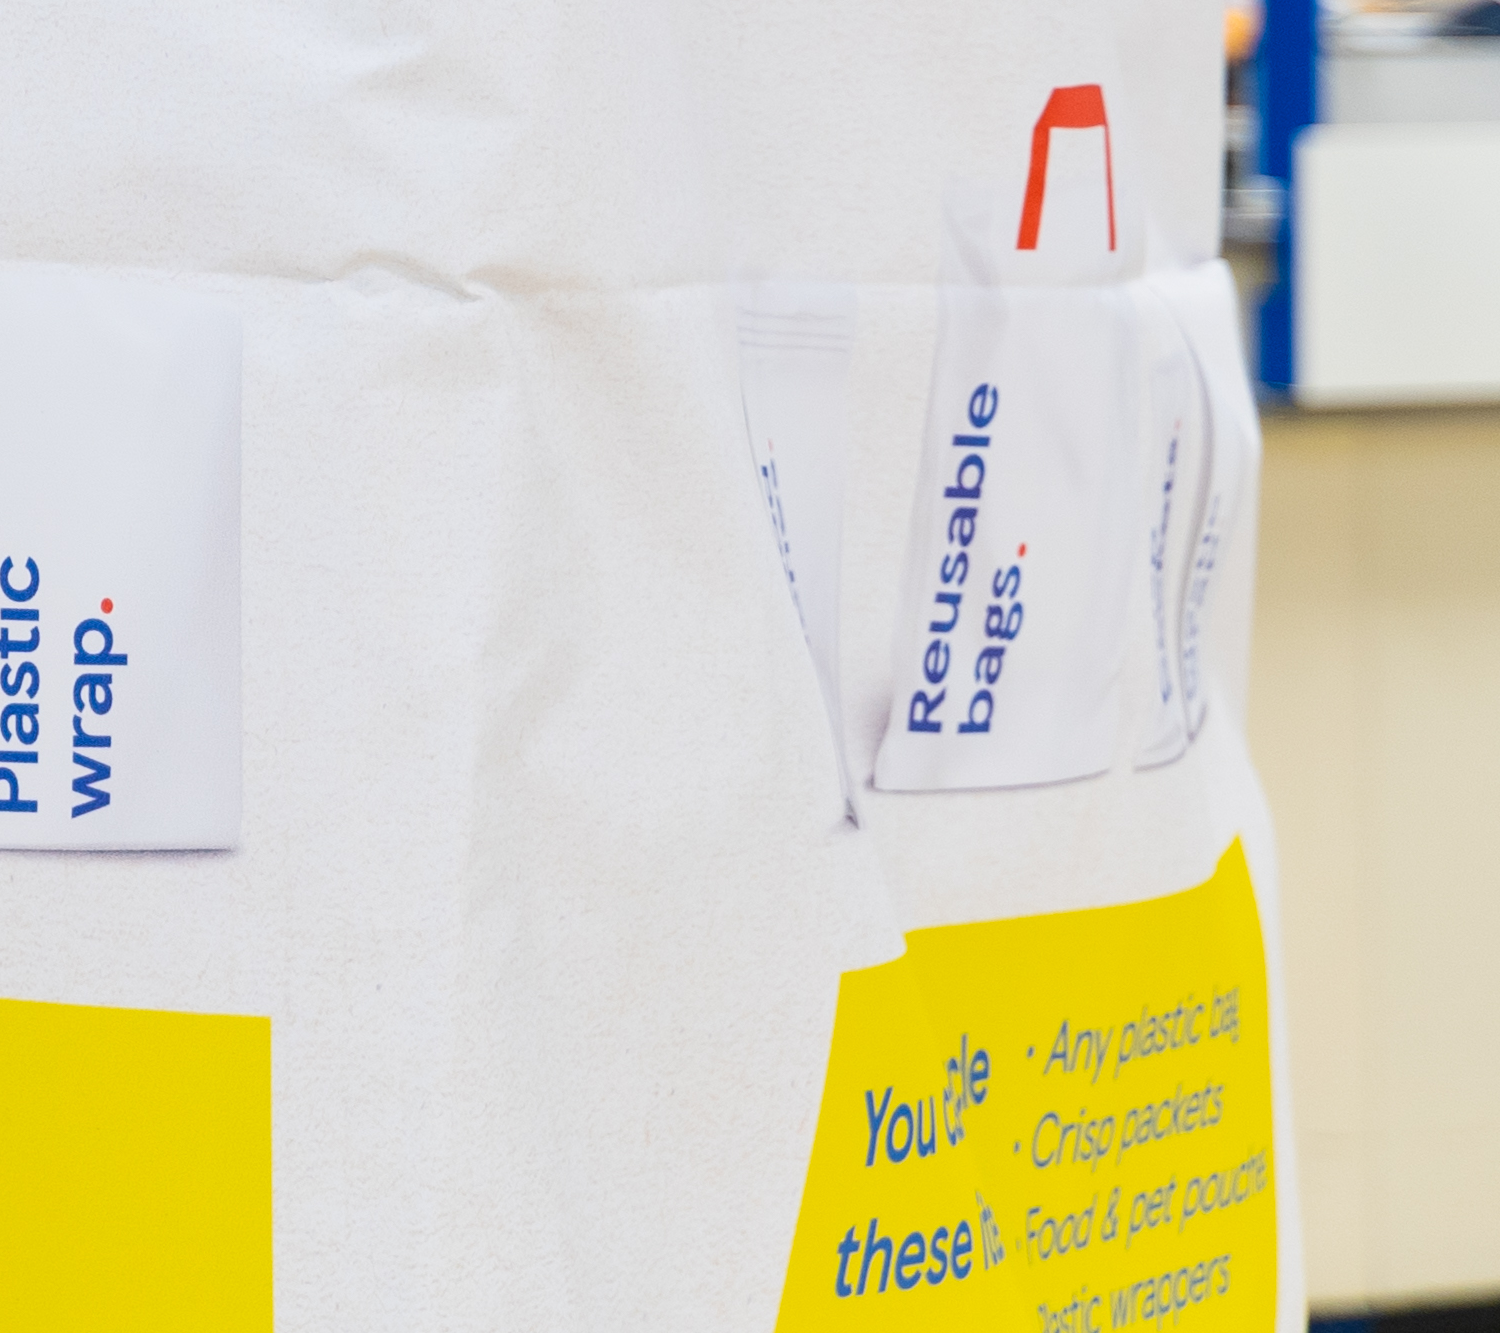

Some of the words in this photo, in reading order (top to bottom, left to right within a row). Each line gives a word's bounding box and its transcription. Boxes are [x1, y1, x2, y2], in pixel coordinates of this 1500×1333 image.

[908, 382, 1001, 736] Reusable
[957, 541, 1029, 736] bags.
[71, 597, 129, 820] wrap.
[1043, 1020, 1114, 1084] Any
[1114, 994, 1206, 1079] plastic
[864, 1085, 938, 1169] You
[1031, 1107, 1115, 1173] Crisp
[1116, 1080, 1225, 1166] packets
[834, 1217, 975, 1299] these
[1025, 1193, 1098, 1264] Food
[1100, 1186, 1121, 1242] &
[1125, 1175, 1177, 1249] pet
[1109, 1253, 1232, 1332] wrappers
